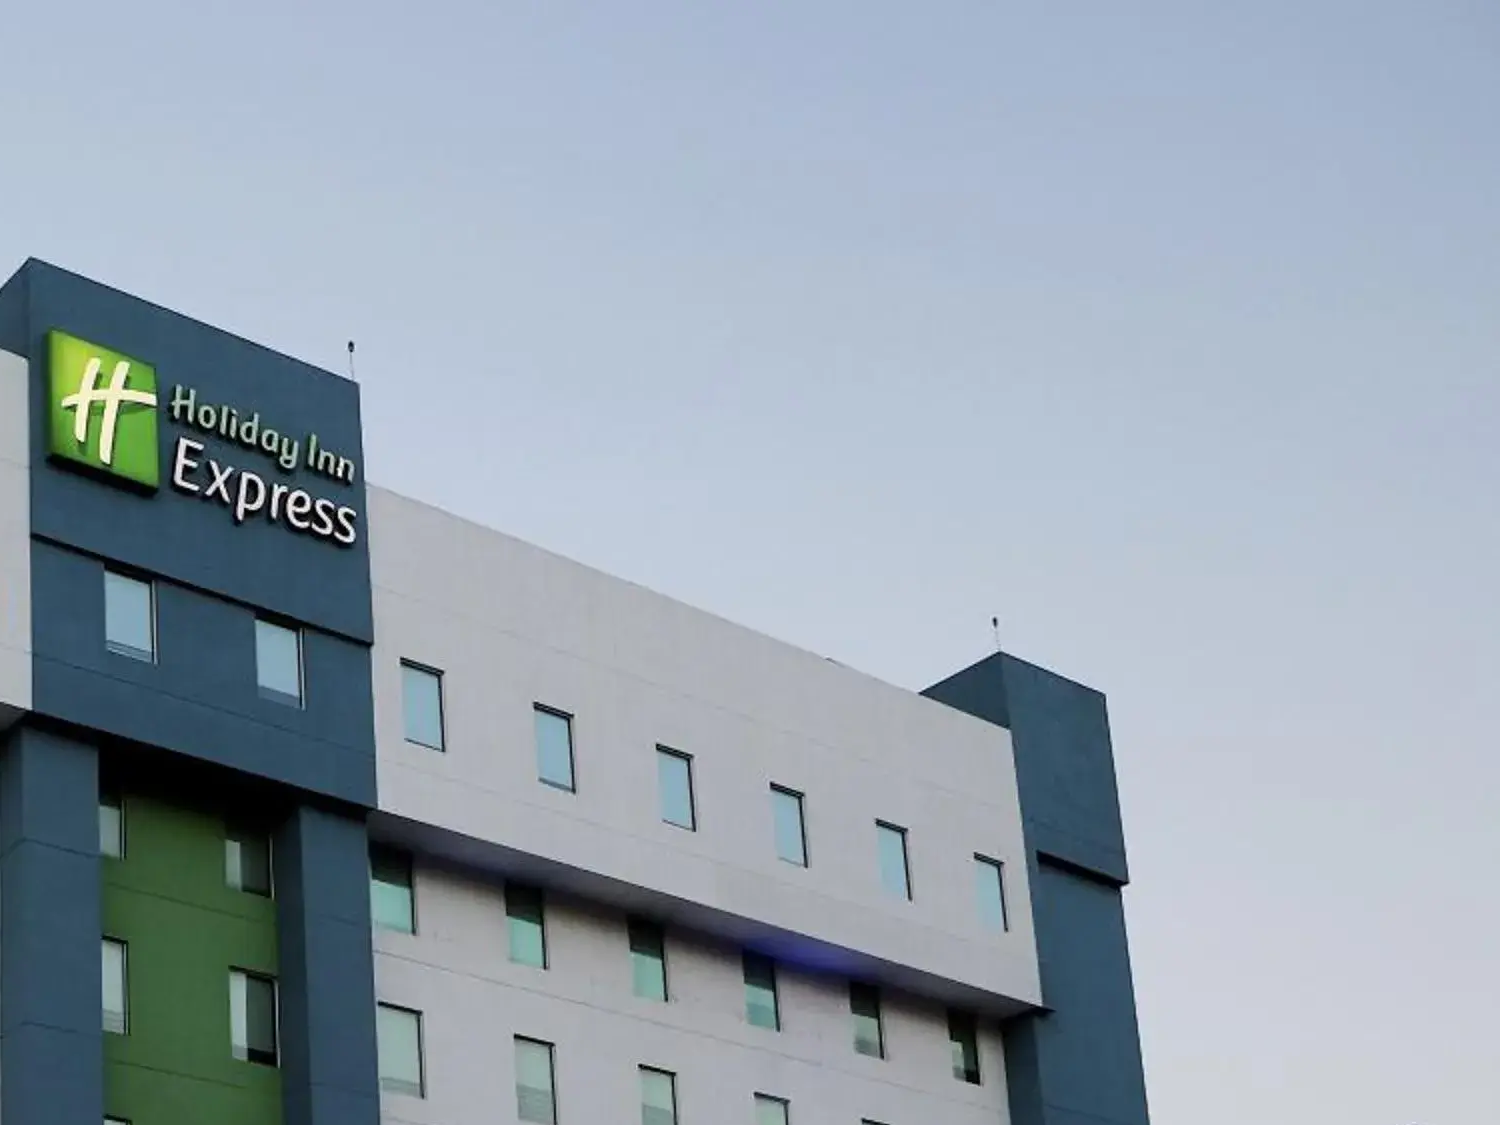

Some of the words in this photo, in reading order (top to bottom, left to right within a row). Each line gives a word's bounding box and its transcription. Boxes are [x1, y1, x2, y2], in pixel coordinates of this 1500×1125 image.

[171, 383, 299, 470] Holiday
[307, 433, 355, 484] Inn
[173, 436, 357, 544] Express
